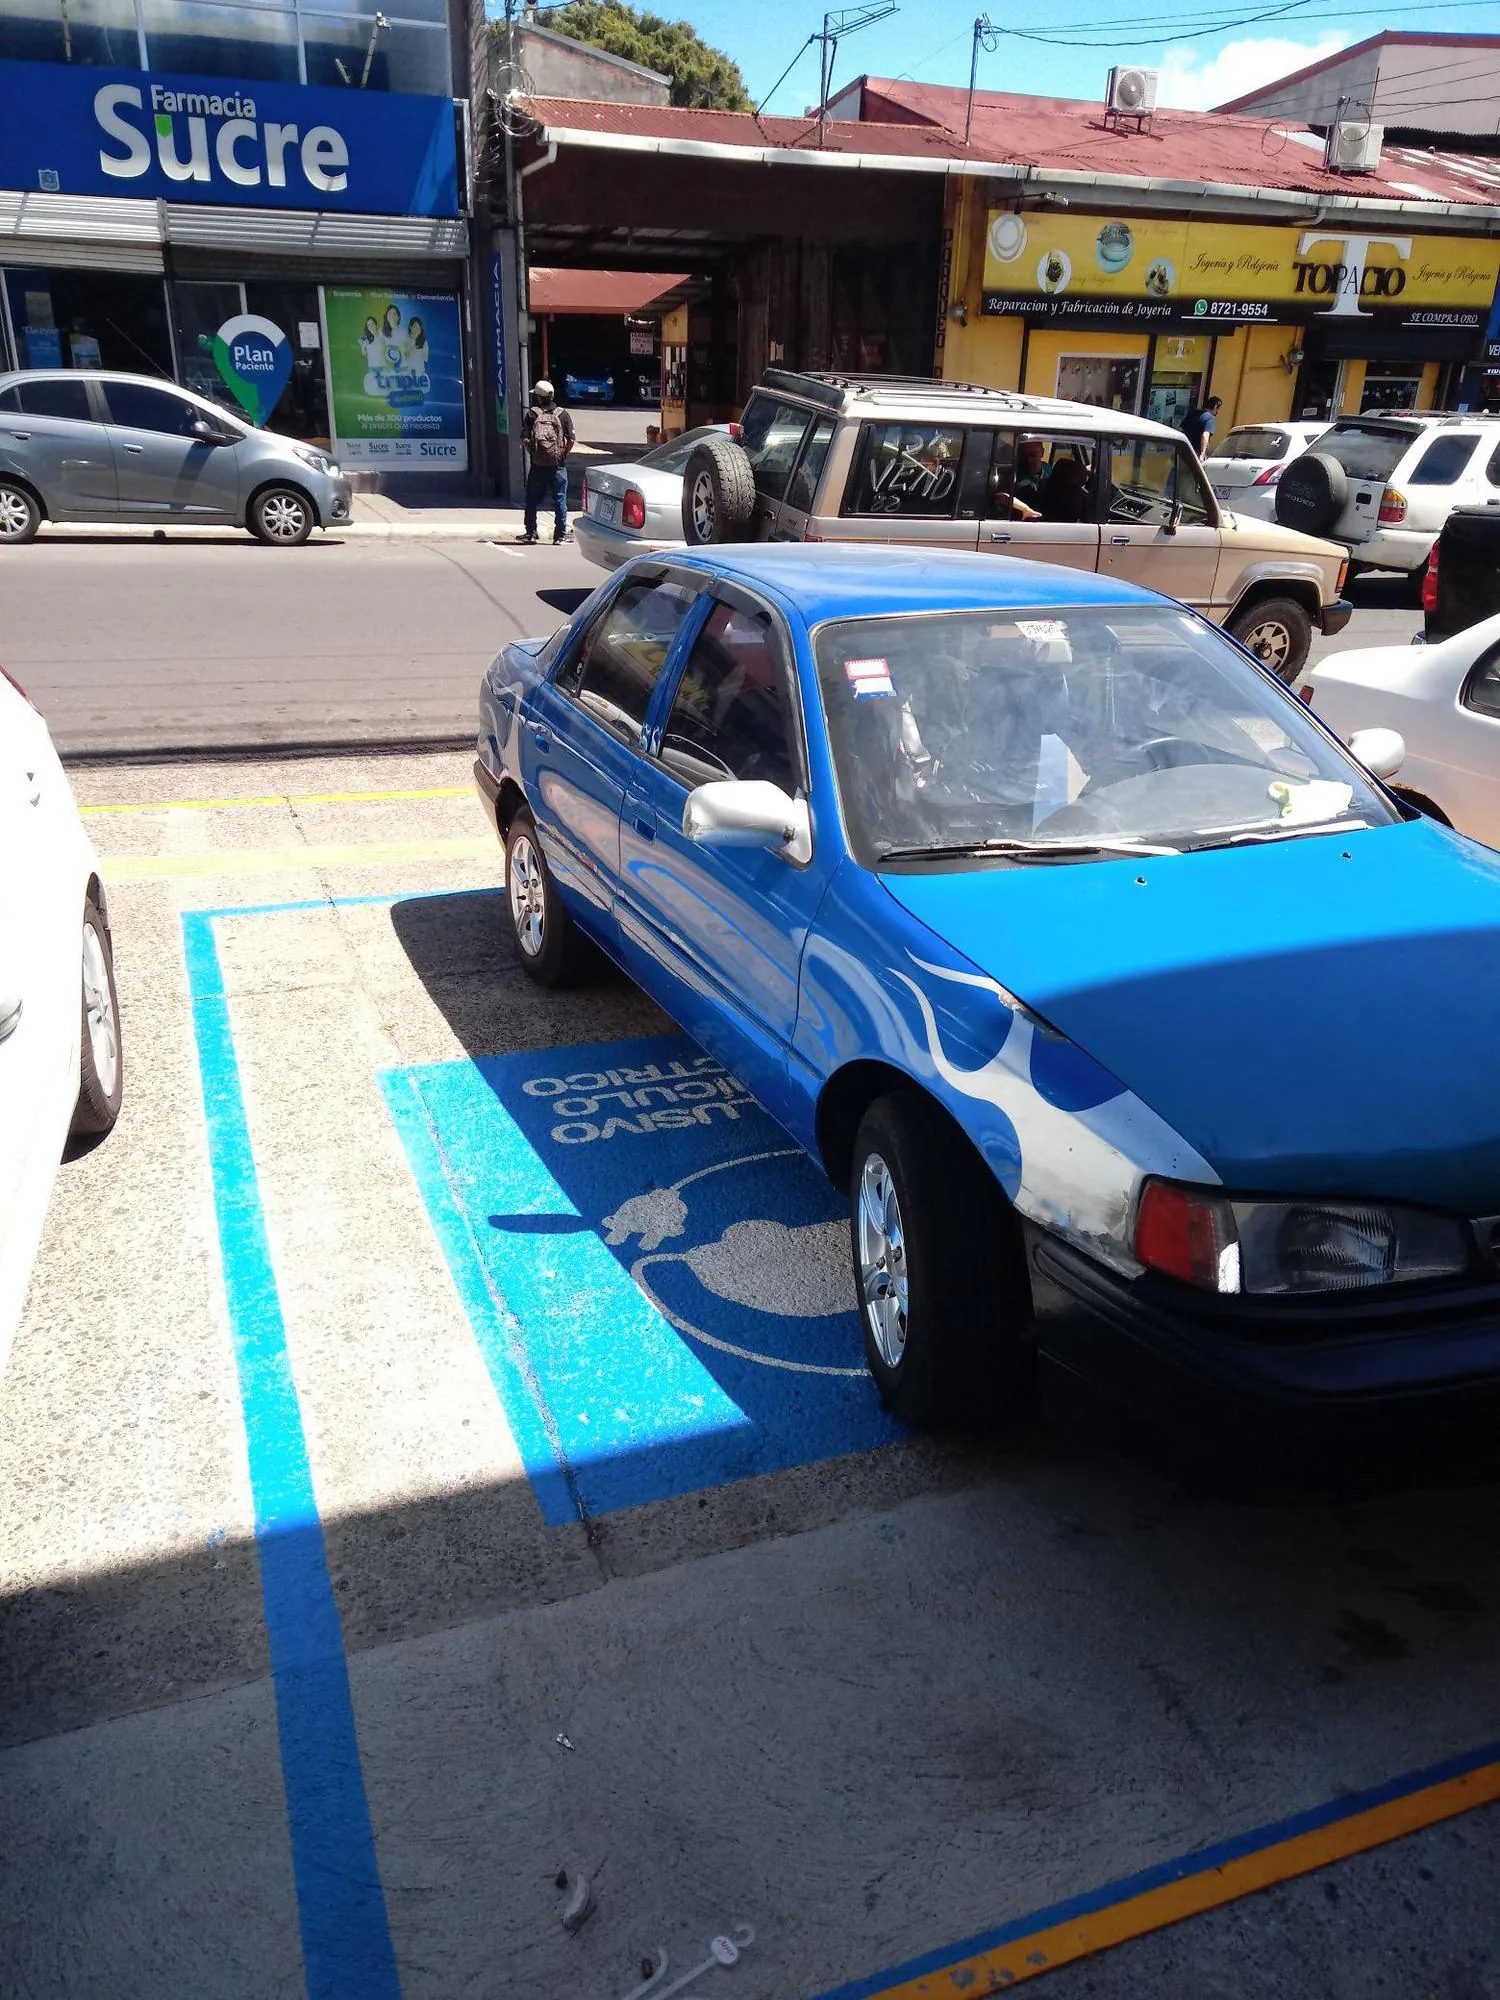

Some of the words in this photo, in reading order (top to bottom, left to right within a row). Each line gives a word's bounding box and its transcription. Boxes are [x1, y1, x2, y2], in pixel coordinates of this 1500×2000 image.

[150, 84, 256, 118] Farmacia
[94, 84, 349, 192] Sucre
[1292, 262, 1406, 297] TOPACIO
[1051, 302, 1058, 316] y
[1059, 300, 1119, 314] Fabricación
[1122, 302, 1133, 315] de
[1134, 303, 1172, 318] Joyería
[1210, 302, 1268, 316] 8721-9554
[1410, 312, 1422, 322] SE
[1422, 313, 1459, 323] COMPRA
[1460, 314, 1478, 324] ORO
[493, 262, 504, 397] FARMACIA
[234, 344, 274, 362] Plan
[235, 361, 275, 371] Paciente
[375, 369, 429, 390] triple
[403, 415, 442, 423] productos
[368, 442, 389, 450] Sucre
[420, 443, 457, 456] Sucre
